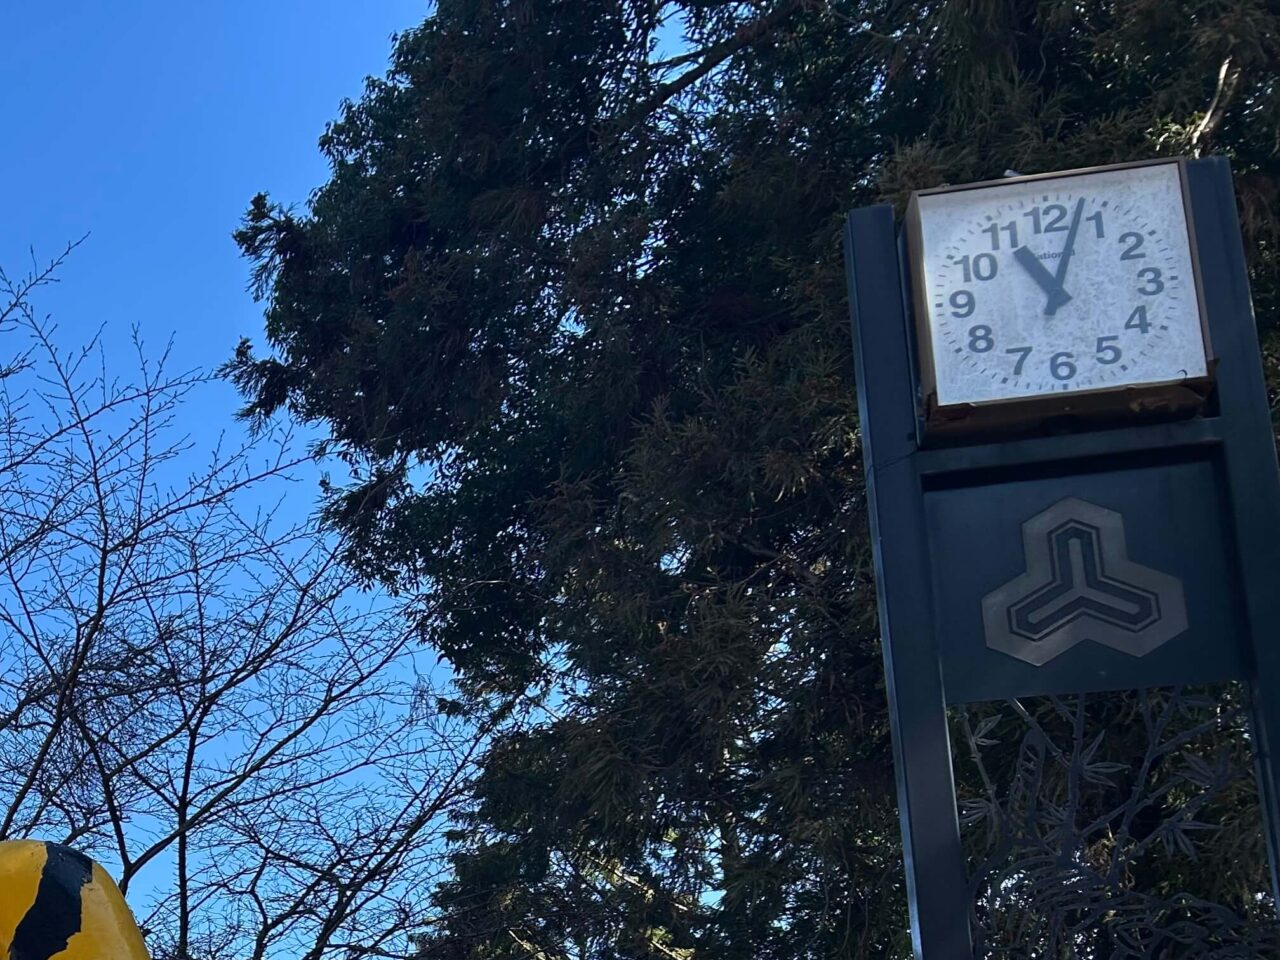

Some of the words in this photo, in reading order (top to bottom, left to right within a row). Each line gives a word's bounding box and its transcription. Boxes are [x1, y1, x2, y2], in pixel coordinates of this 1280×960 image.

[1023, 204, 1069, 235] 12
[1086, 211, 1105, 239] 1
[982, 221, 1020, 251] 11
[1118, 231, 1146, 261] 2
[953, 253, 998, 283] 10
[1137, 266, 1164, 297] 3
[949, 289, 975, 319] 9
[1125, 305, 1152, 335] 4
[968, 324, 994, 354] 8
[1096, 335, 1121, 366] 5
[1006, 346, 1033, 376] 7
[1050, 352, 1077, 381] 6
